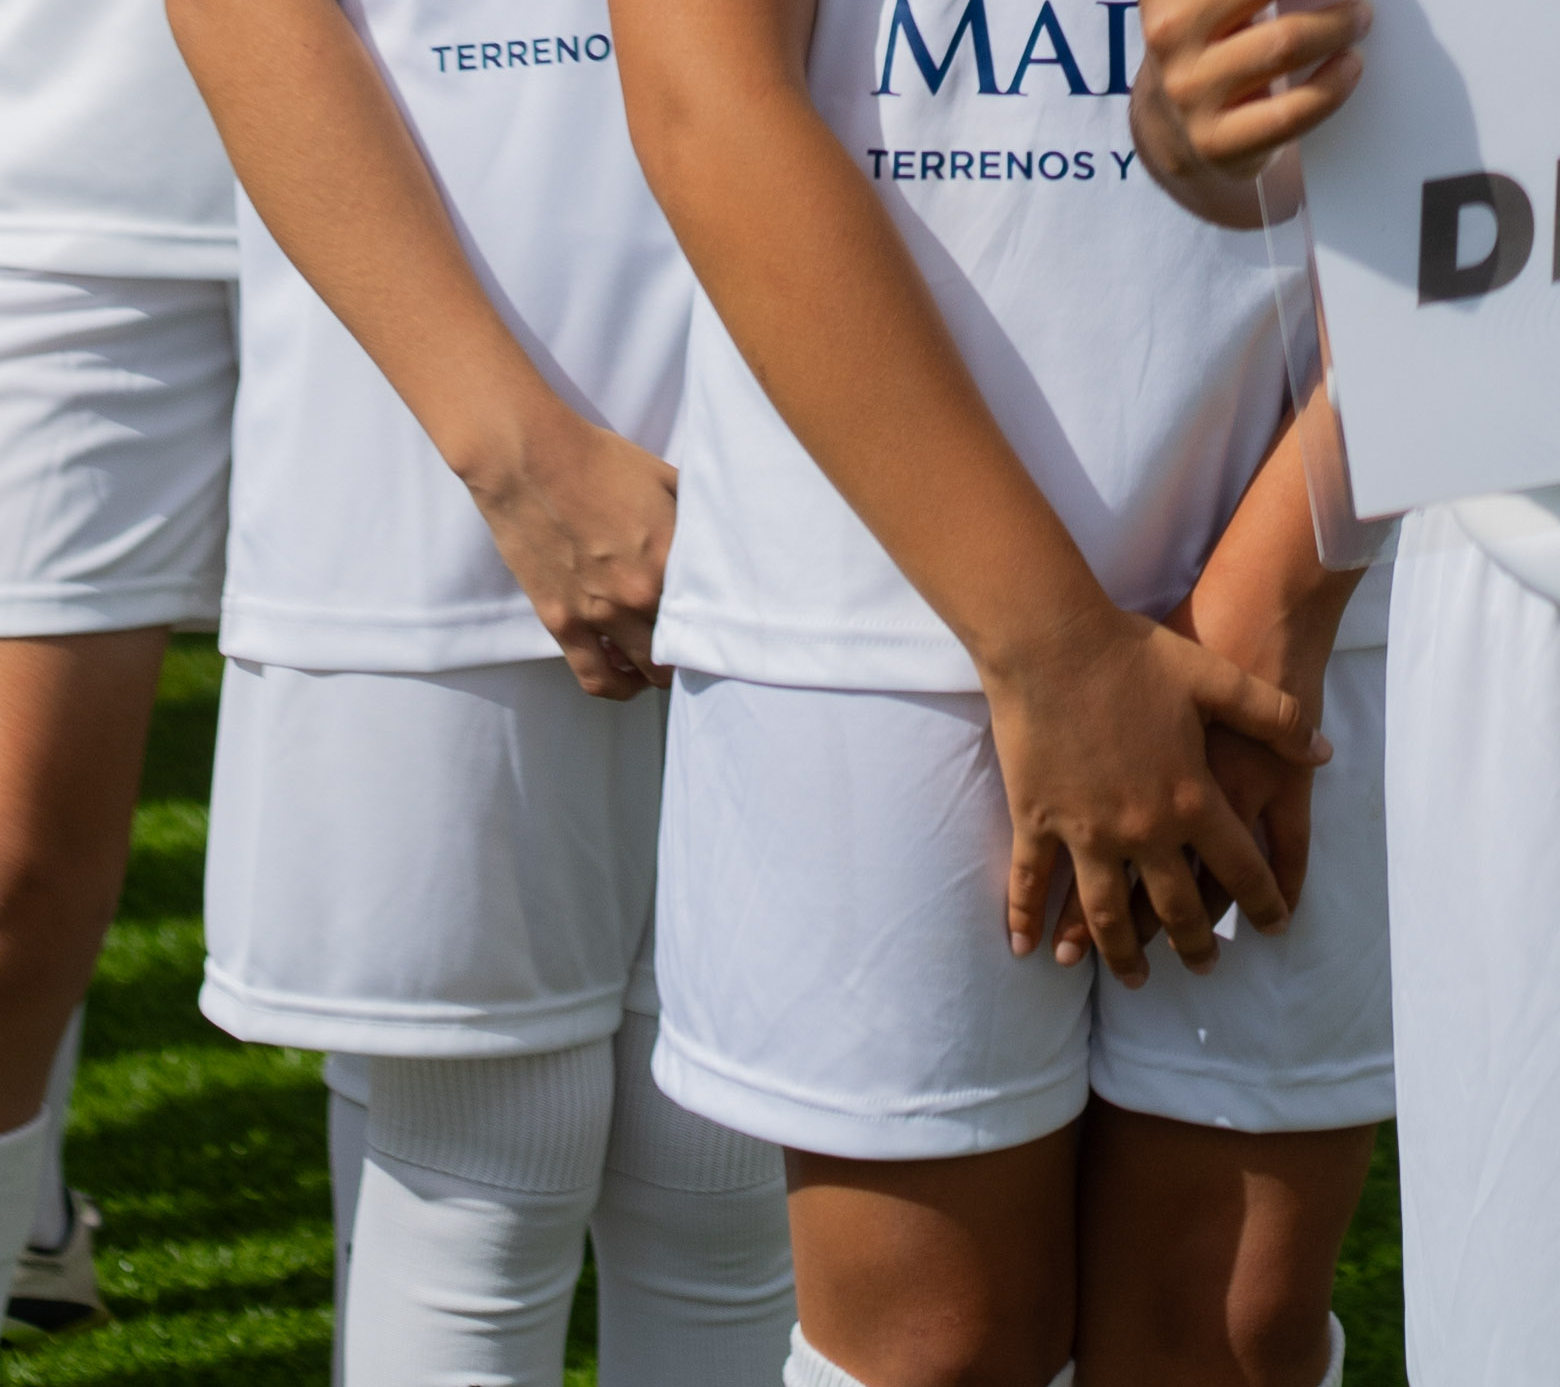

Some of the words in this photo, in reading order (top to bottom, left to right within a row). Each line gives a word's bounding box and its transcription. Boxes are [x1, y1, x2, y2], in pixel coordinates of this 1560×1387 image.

[431, 33, 612, 73] TERRENO
[867, 148, 1096, 180] TERRENOS
[1110, 150, 1137, 180] Y
